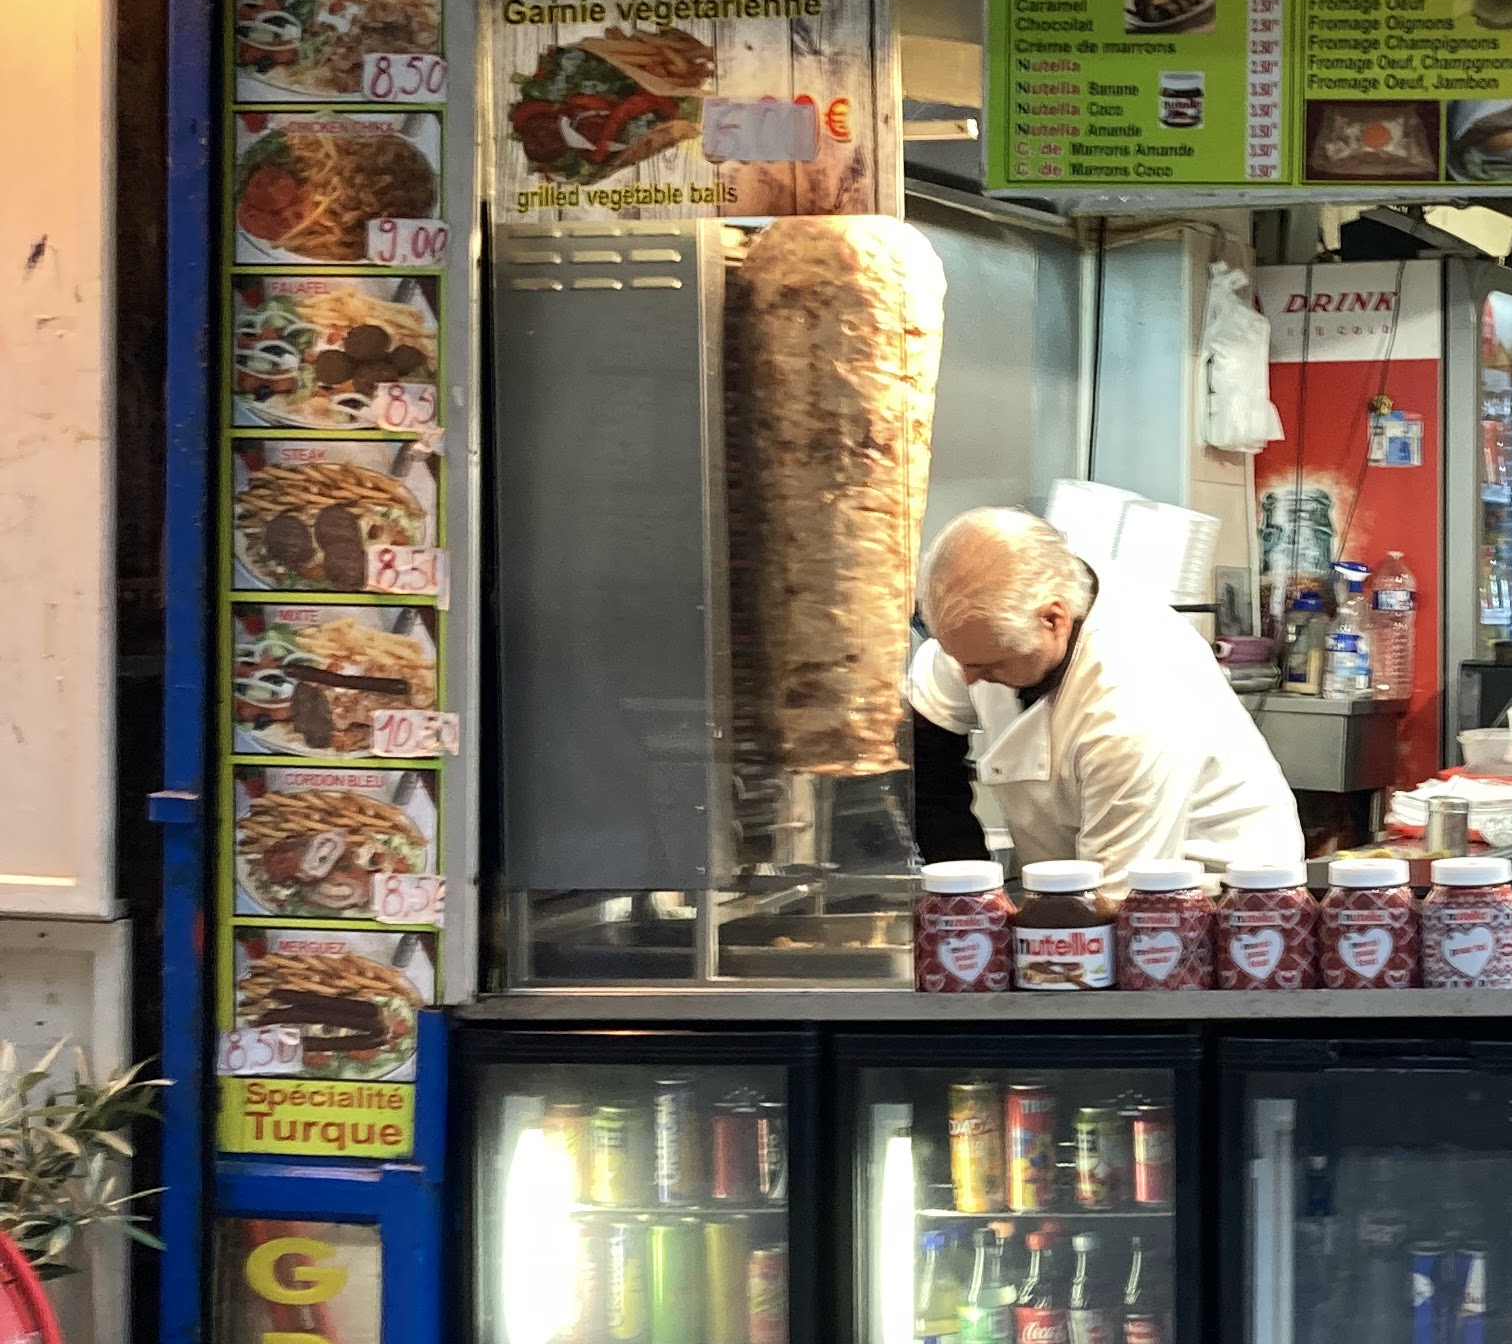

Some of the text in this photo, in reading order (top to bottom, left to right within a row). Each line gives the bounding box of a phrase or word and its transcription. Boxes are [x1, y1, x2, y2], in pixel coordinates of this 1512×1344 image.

[516, 181, 738, 213] grilled vegetable balls
[1283, 291, 1398, 314] DRINK
[1015, 933, 1106, 957] nutella
[245, 1081, 404, 1117] Spécialité
[246, 1112, 403, 1150] Turque
